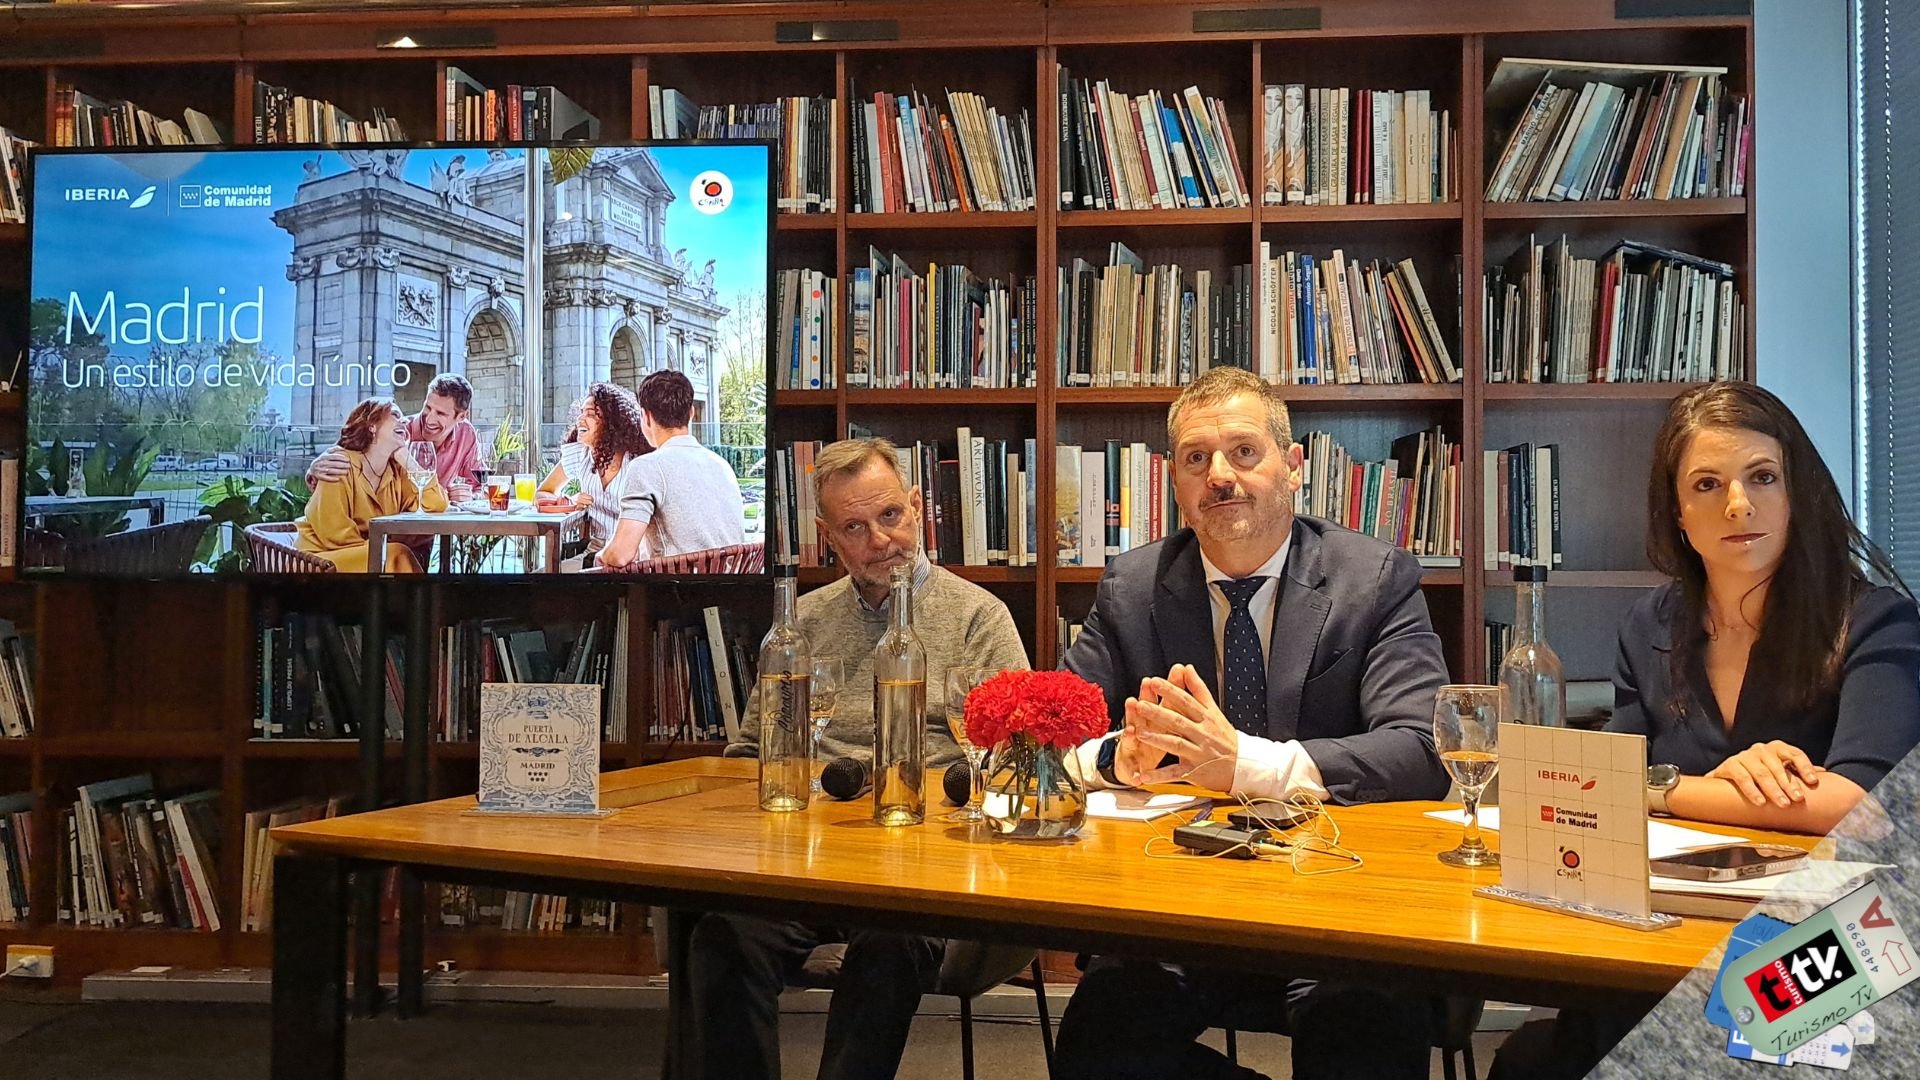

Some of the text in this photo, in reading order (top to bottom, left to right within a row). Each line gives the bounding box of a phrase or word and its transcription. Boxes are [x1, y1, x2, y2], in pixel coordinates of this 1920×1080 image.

[1521, 121, 1536, 144] MARINO
[64, 188, 130, 201] IBERIA
[204, 185, 272, 196] Comunidad
[204, 196, 272, 207] de Madrid
[64, 286, 264, 345] Madrid
[62, 354, 411, 388] Un estilo de vida único
[974, 440, 982, 461] ART
[974, 471, 984, 506] WORK
[1384, 470, 1396, 526] NO BRASIL
[524, 725, 554, 733] PUERTA
[508, 734, 569, 744] DE ALCALA
[1538, 770, 1580, 784] IBERIA
[1556, 807, 1598, 820] Comunidad
[1556, 817, 1598, 830] de Madrid
